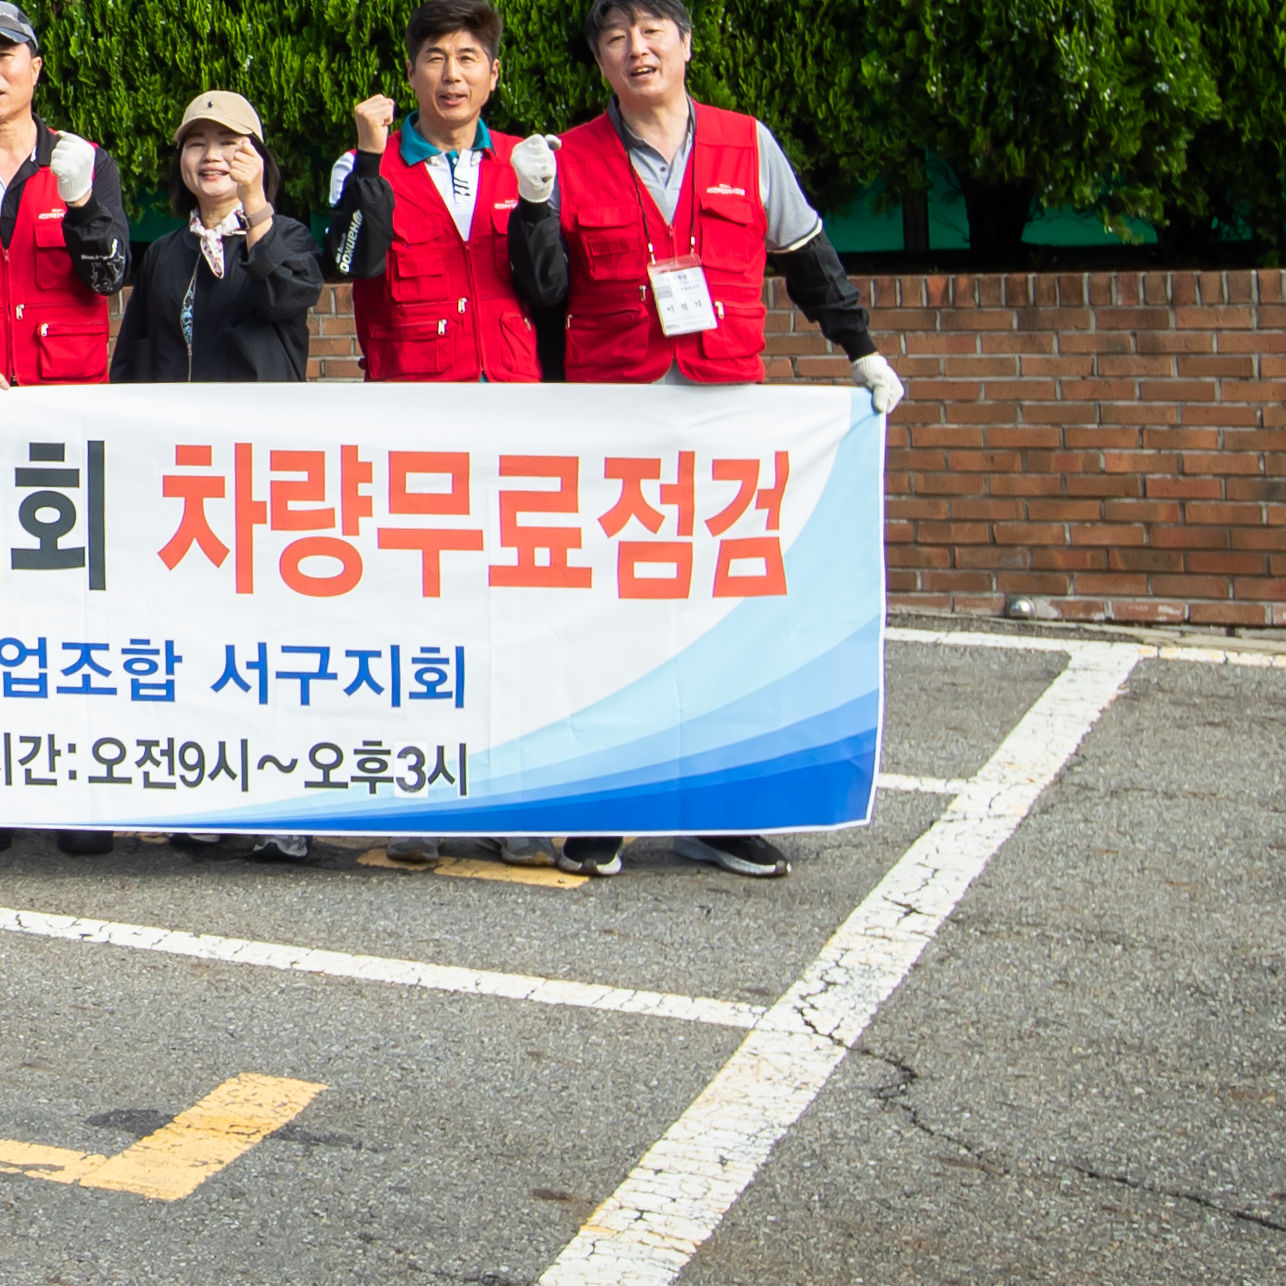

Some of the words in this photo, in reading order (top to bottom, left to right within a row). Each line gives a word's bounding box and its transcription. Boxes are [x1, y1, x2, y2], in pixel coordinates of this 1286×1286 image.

[339, 220, 363, 275] Hankoo
[158, 442, 790, 600] 차량무료점검
[211, 642, 465, 708] 서구지회
